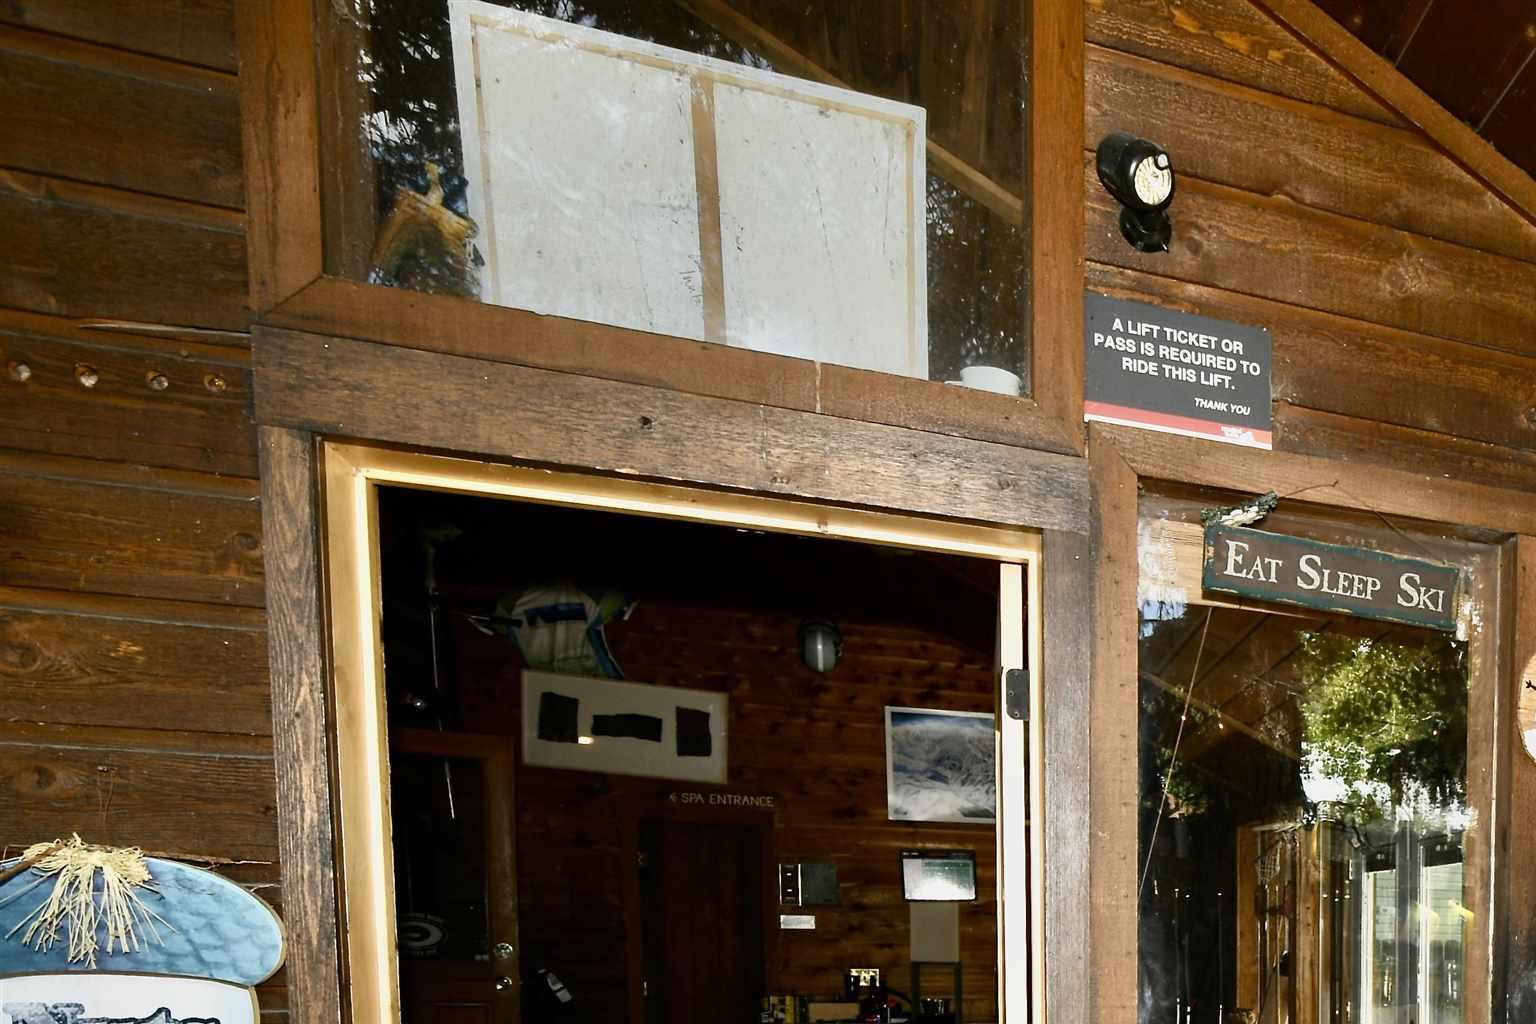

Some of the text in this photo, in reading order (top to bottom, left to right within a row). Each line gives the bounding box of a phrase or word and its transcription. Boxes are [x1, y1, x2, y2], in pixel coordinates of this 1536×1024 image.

[1112, 318, 1243, 355] A LIFT TICKET OR
[1094, 333, 1261, 376] PASS IS REQUIRED TO
[1122, 357, 1235, 390] RIDE THIS LIFT.
[1194, 397, 1250, 416] THANK YOU
[681, 793, 775, 807] SPA ENTRANCE
